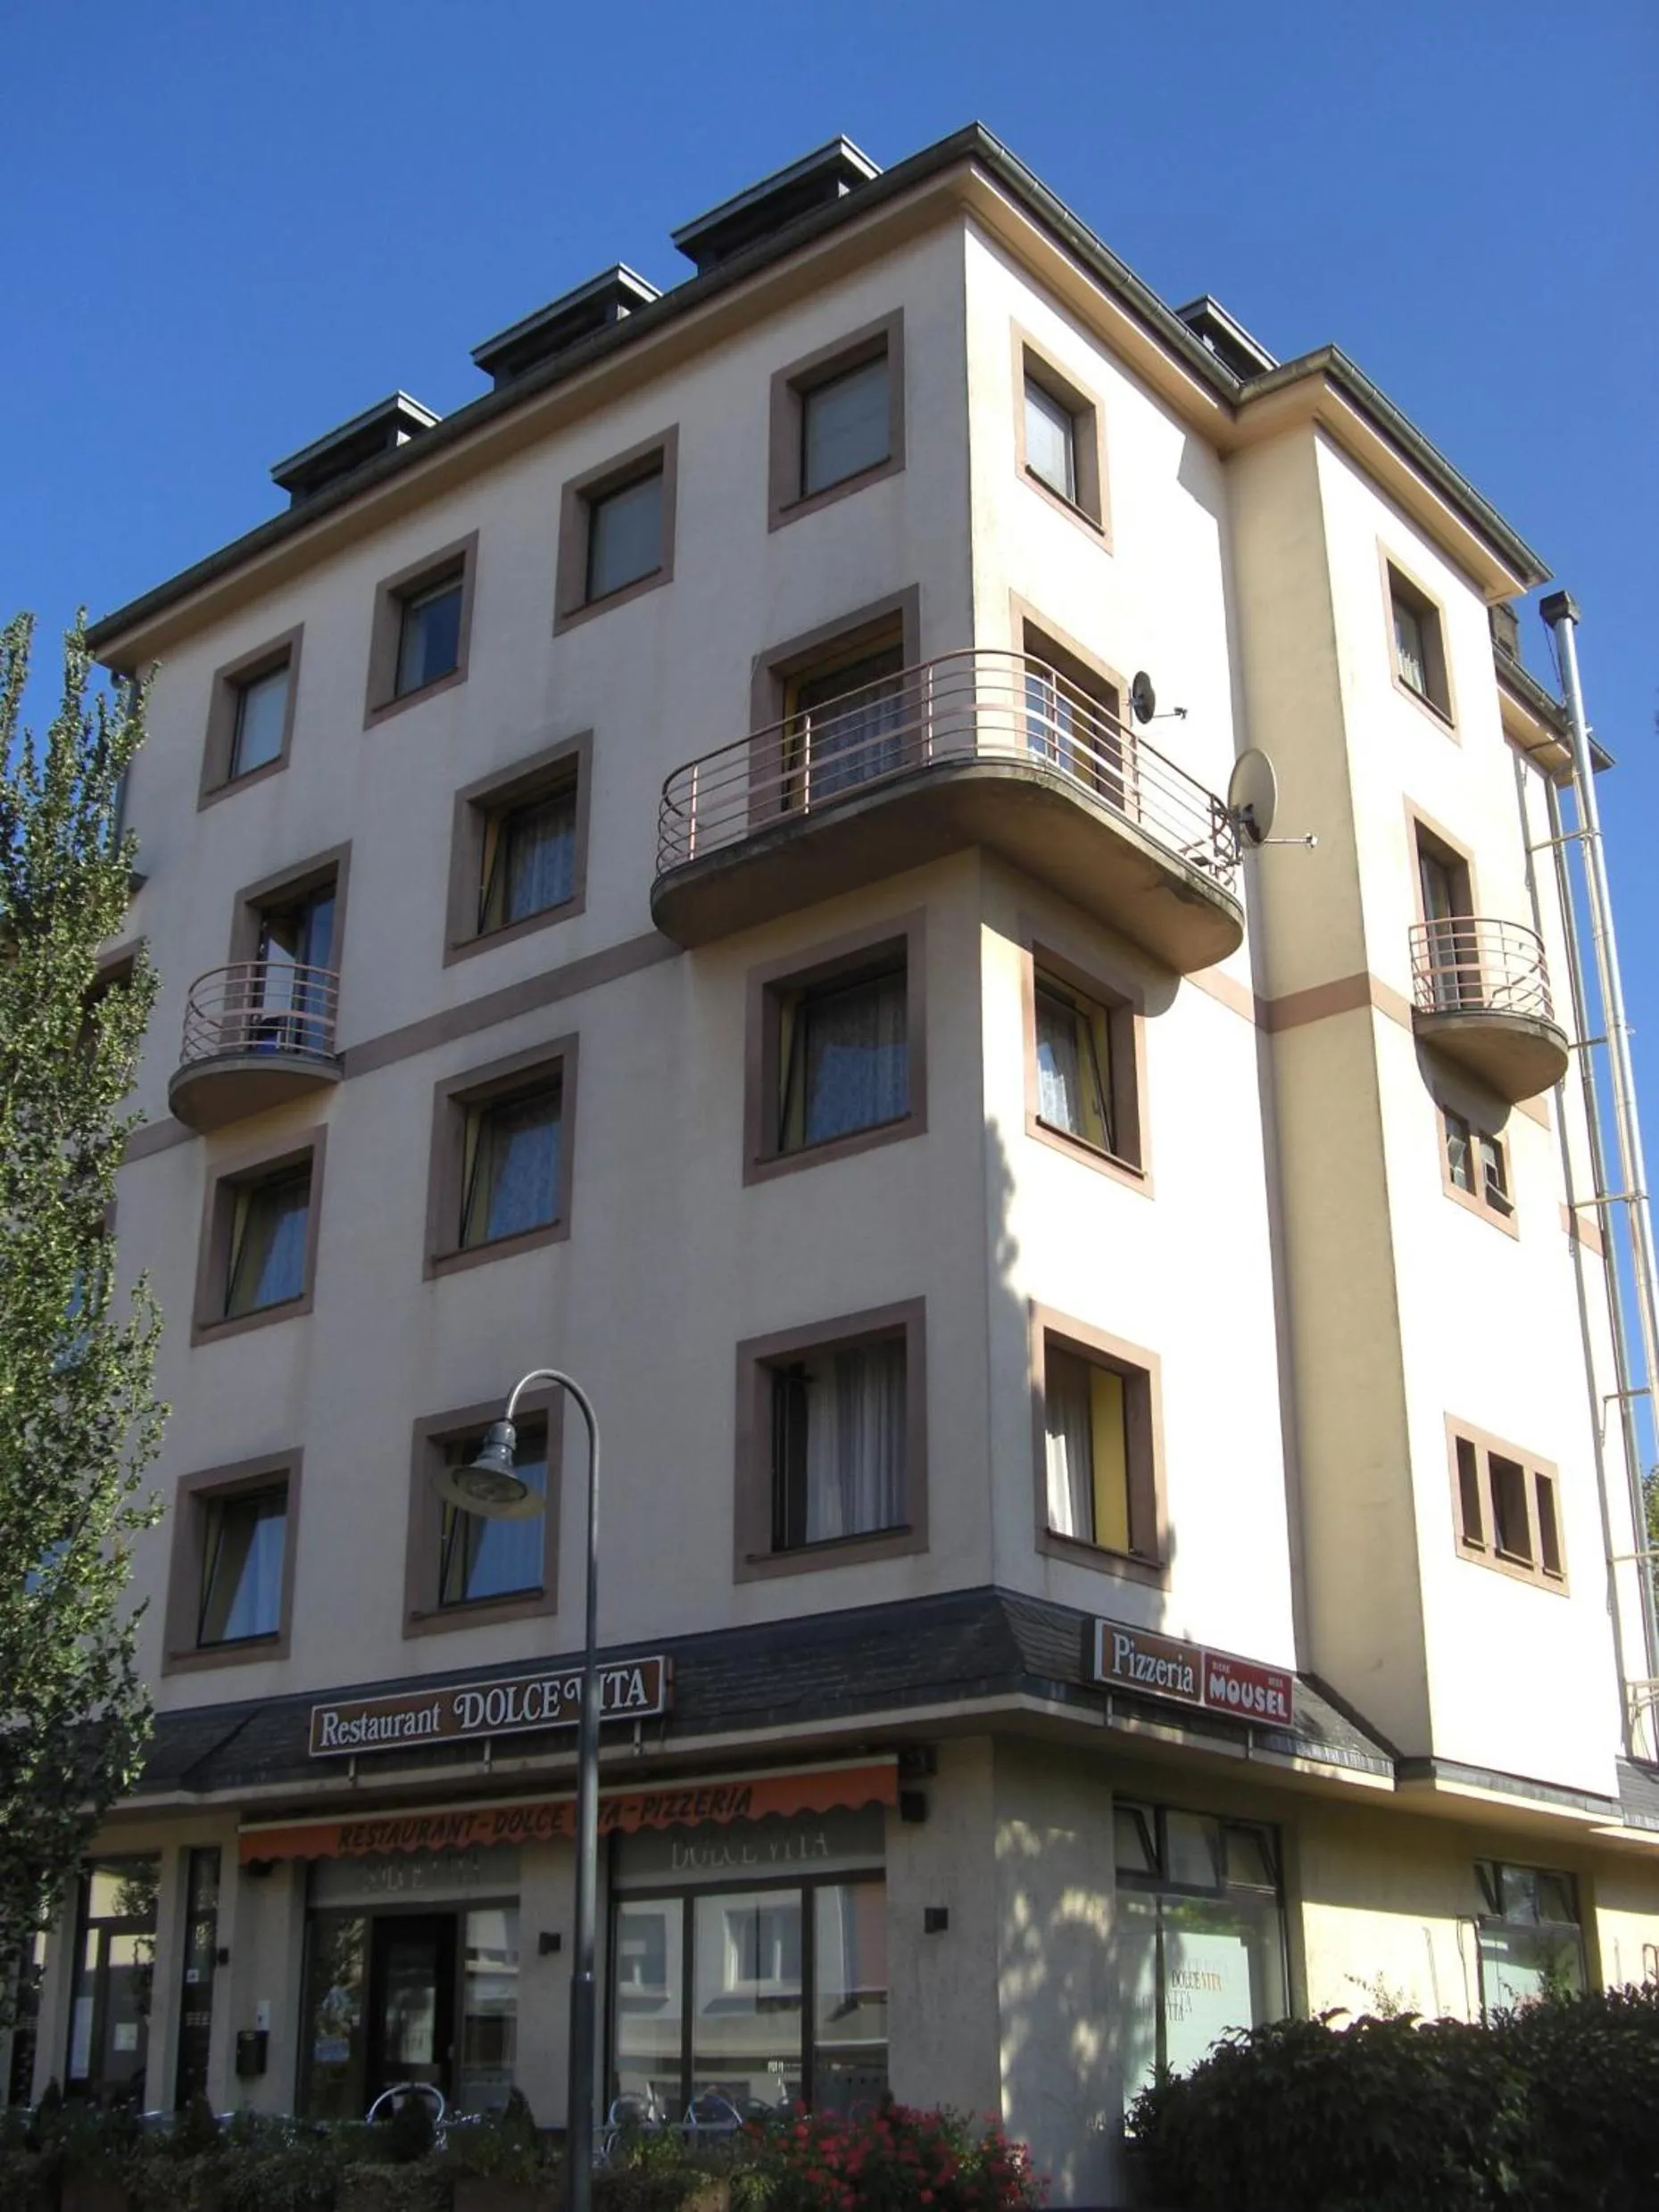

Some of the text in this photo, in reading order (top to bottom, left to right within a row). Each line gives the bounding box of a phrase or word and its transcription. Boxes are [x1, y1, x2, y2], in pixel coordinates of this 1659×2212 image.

[1112, 1632, 1194, 1694] Pizzeria
[319, 1703, 441, 1747] Restaurant
[452, 1680, 561, 1729] DOLCE
[1209, 1672, 1289, 1718] MOUSEL
